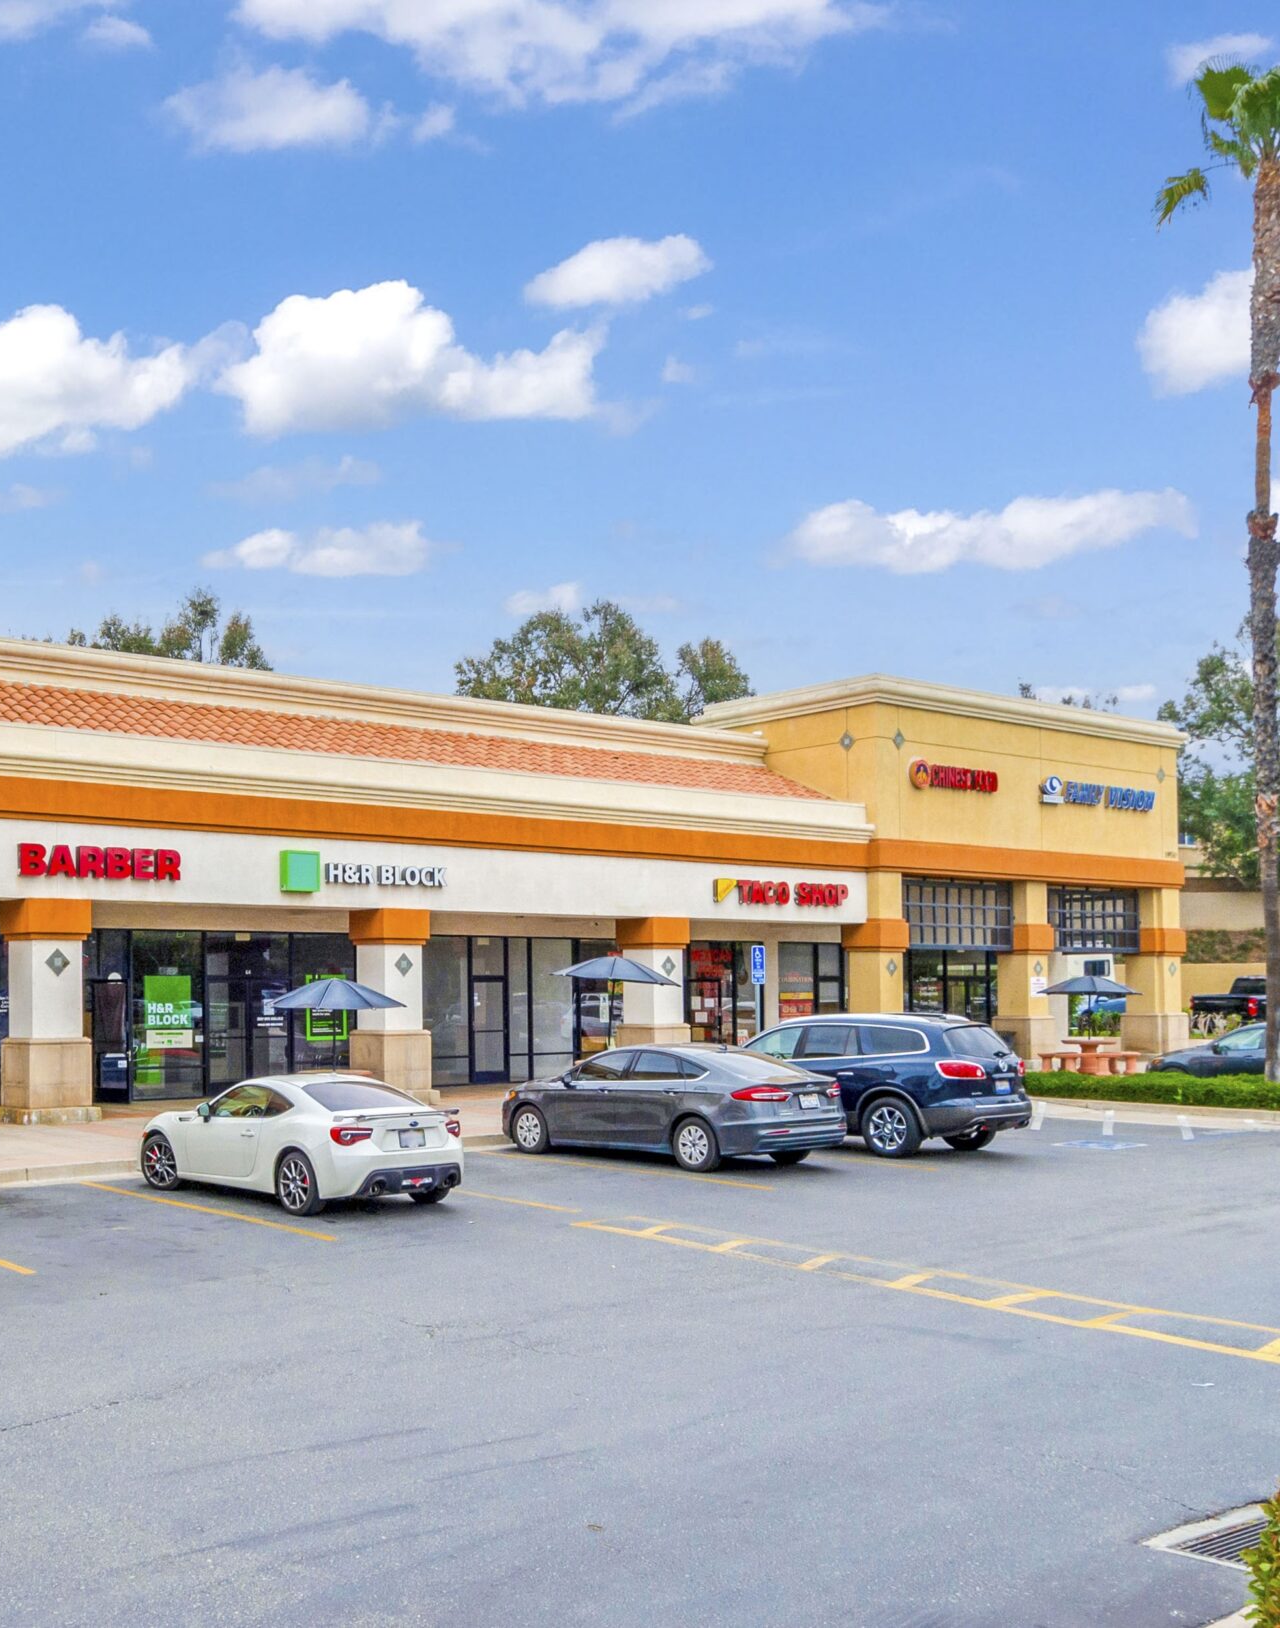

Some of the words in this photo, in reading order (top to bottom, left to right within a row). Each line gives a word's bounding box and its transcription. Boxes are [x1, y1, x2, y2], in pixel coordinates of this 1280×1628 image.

[1064, 781, 1104, 806] FAMILY
[1105, 786, 1155, 812] VISION
[17, 843, 181, 880] BARBER
[325, 863, 375, 884] H&R
[377, 865, 448, 888] BLOCK
[737, 879, 790, 906] TACO
[794, 882, 849, 907] SHOP
[147, 1003, 174, 1013] H&R
[147, 1014, 188, 1025] BLOCK
